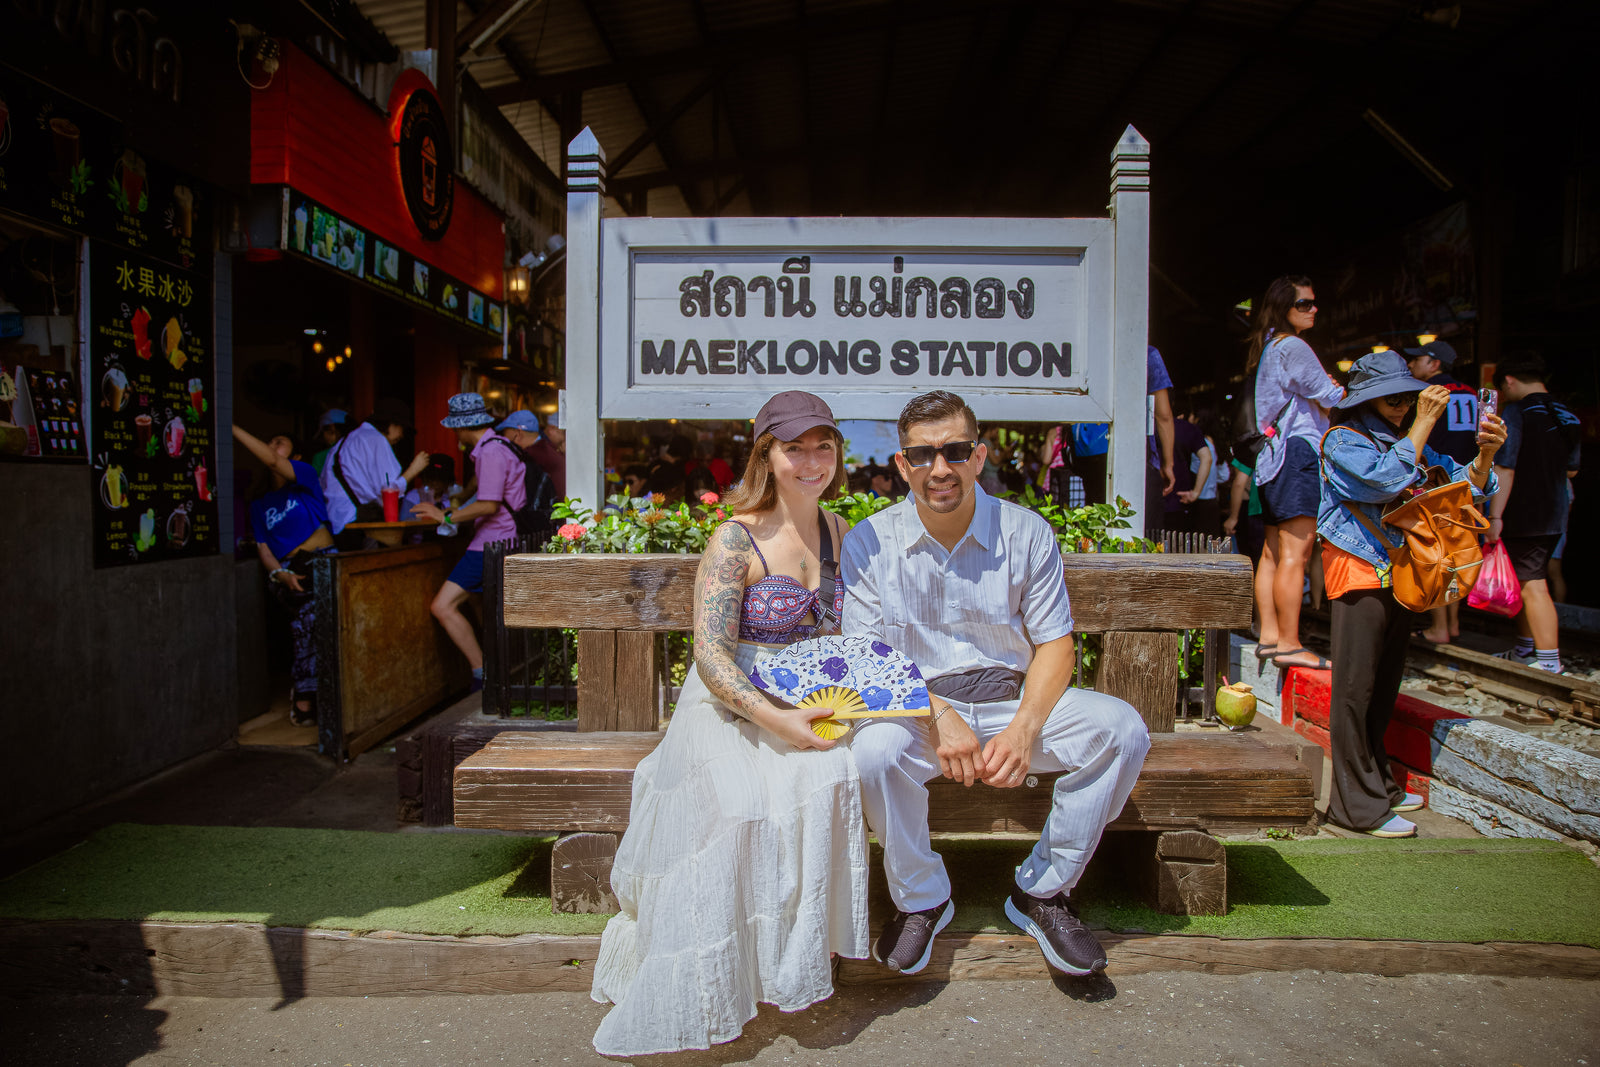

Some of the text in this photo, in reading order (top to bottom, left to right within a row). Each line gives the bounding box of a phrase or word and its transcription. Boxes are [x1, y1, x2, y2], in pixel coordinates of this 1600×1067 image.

[115, 260, 194, 308] 水果冰沙
[679, 256, 1035, 319] สถานี แม่กลอง
[641, 339, 1072, 378] MAEKLONG STATION
[1453, 399, 1475, 424] 11
